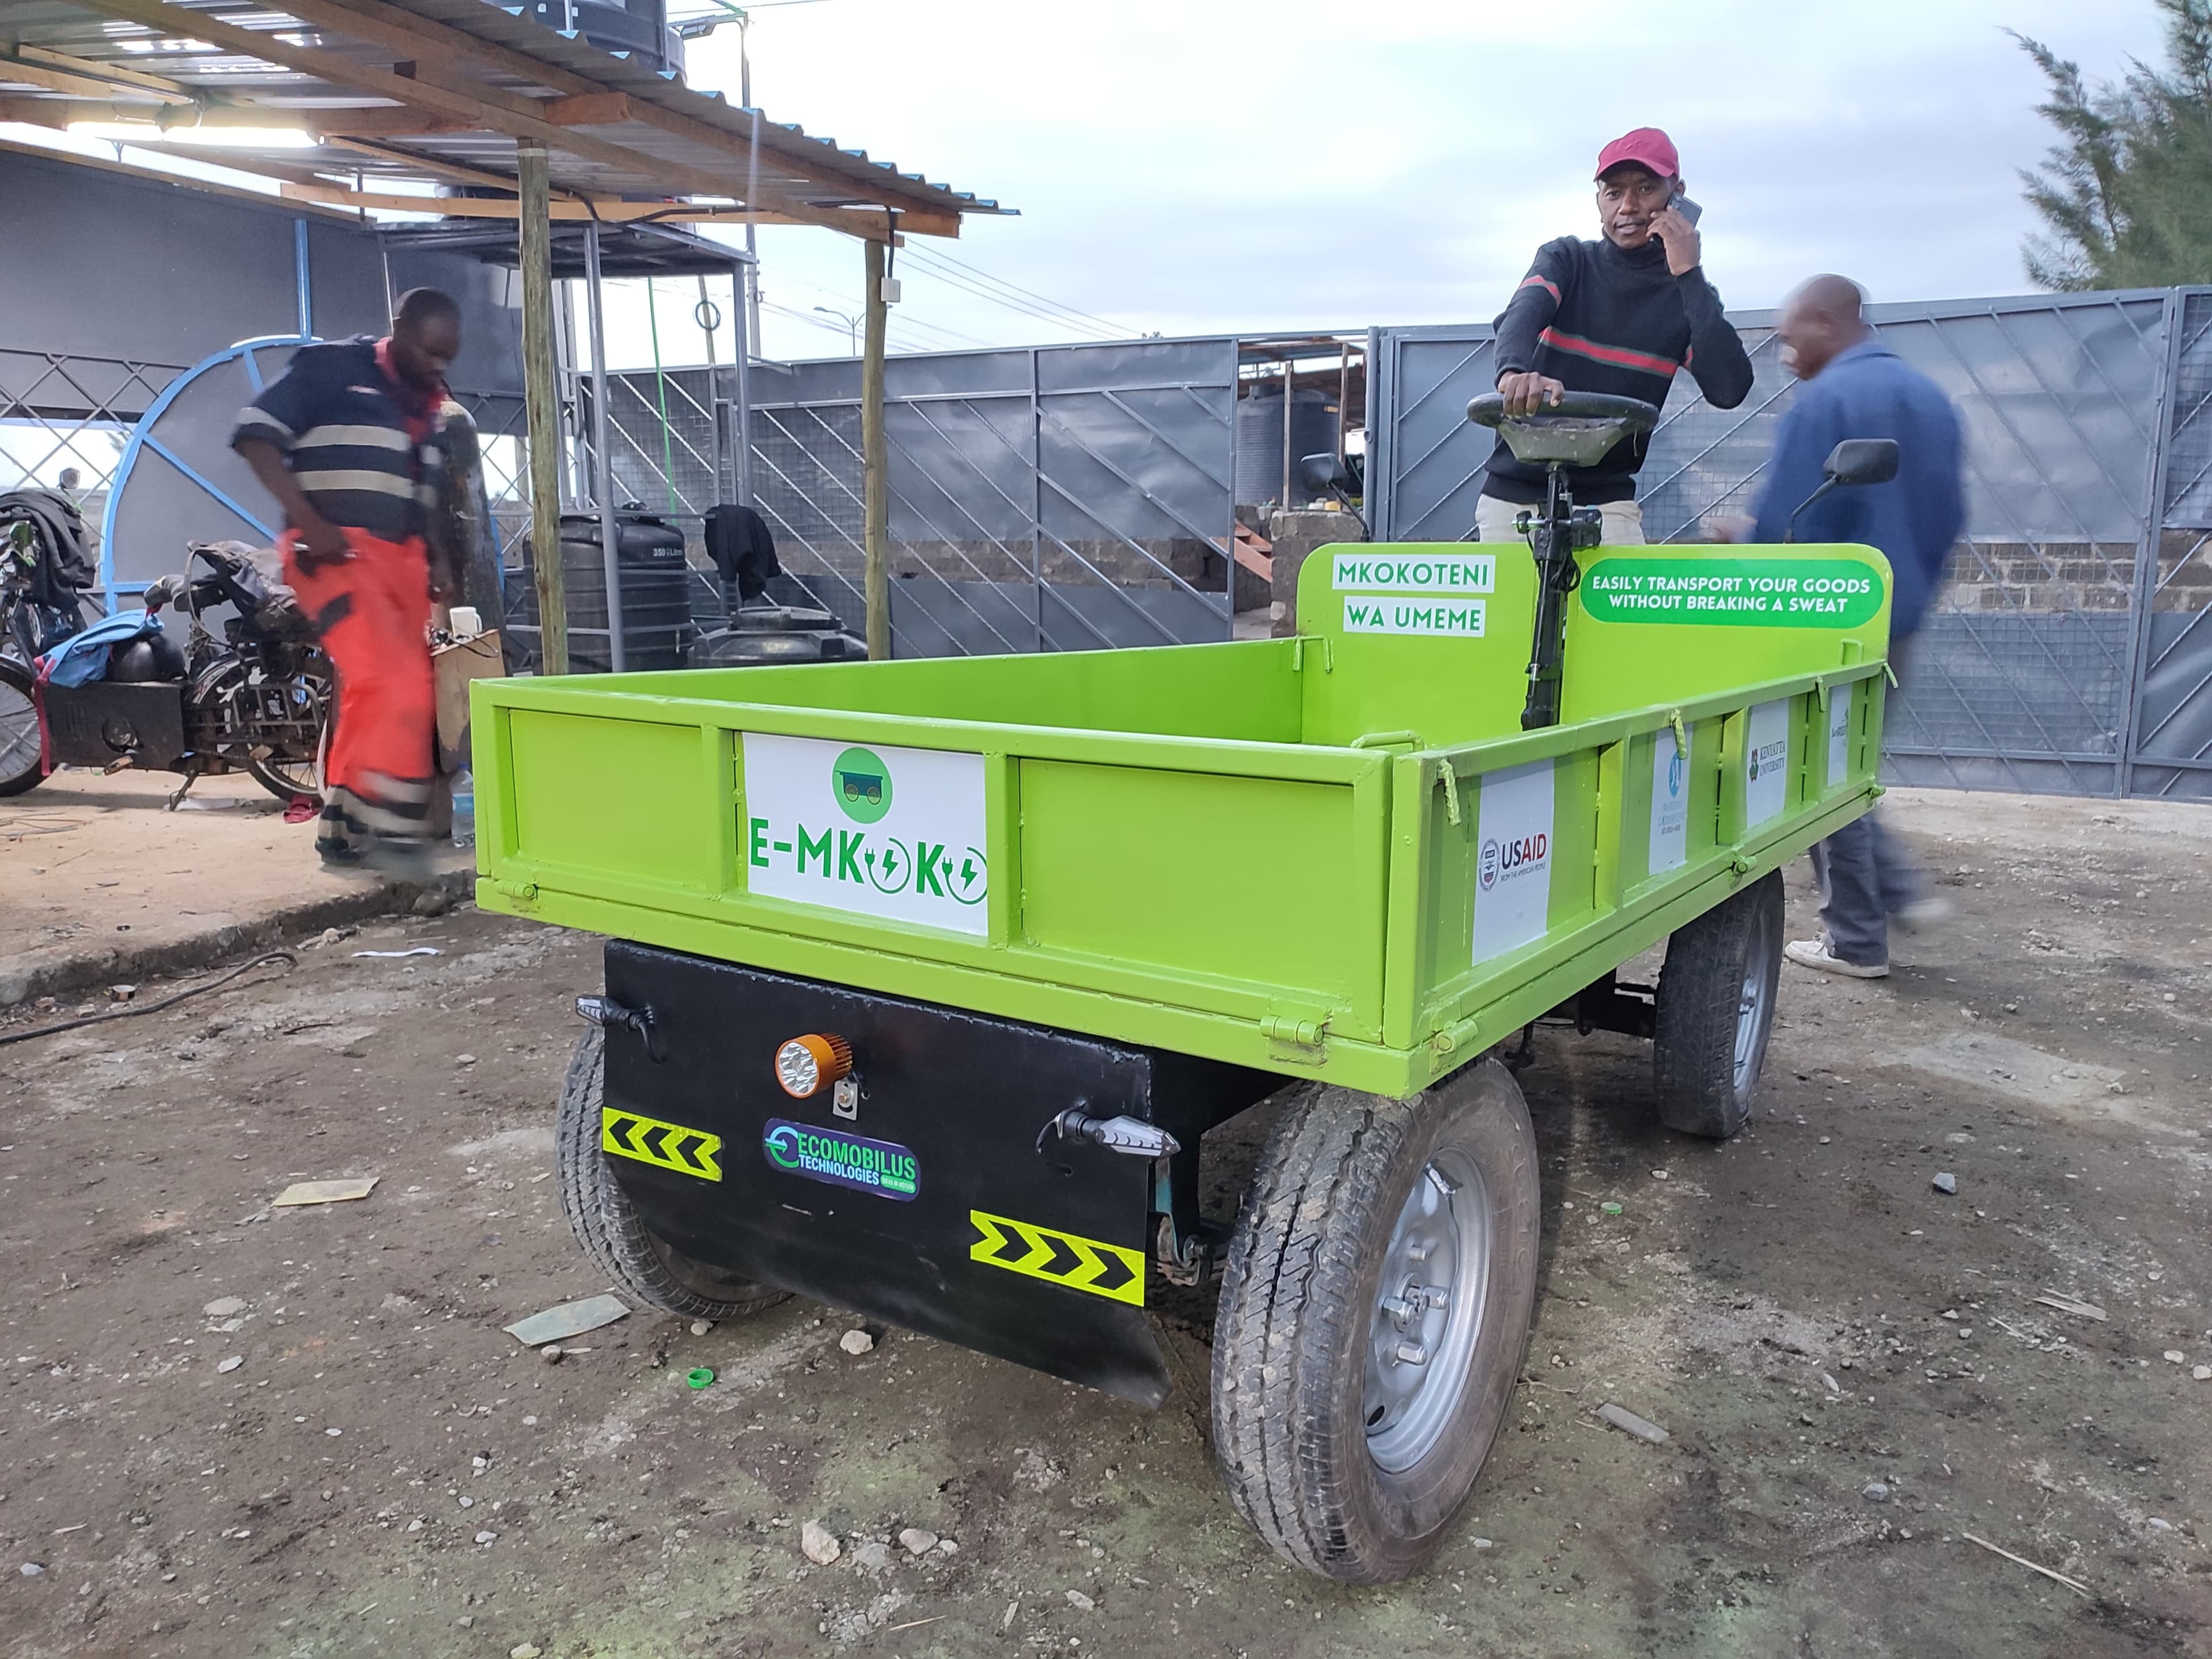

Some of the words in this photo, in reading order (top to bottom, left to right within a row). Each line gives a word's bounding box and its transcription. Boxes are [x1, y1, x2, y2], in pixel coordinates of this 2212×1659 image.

[653, 548, 666, 557] 350
[1338, 562, 1488, 586] MKOKOTENI
[1592, 575, 1643, 590] EASILY
[1647, 576, 1744, 592] TRANSPORT
[1748, 577, 1798, 593] YOUR
[1802, 578, 1870, 594] GOODS
[1608, 594, 1682, 609] WITHOUT
[1686, 595, 1767, 611] BREAKING
[1771, 597, 1783, 612] A
[1789, 597, 1849, 613] SWEAT
[1347, 604, 1385, 627] WA
[1395, 606, 1481, 631] UMEME
[1760, 740, 1786, 760] KENYATTA
[1759, 756, 1785, 777] UNIVERSITY
[1501, 833, 1547, 870] USAID
[797, 1132, 916, 1180] ECOMOBILUS
[798, 1154, 880, 1185] TECHNOLOGIES
